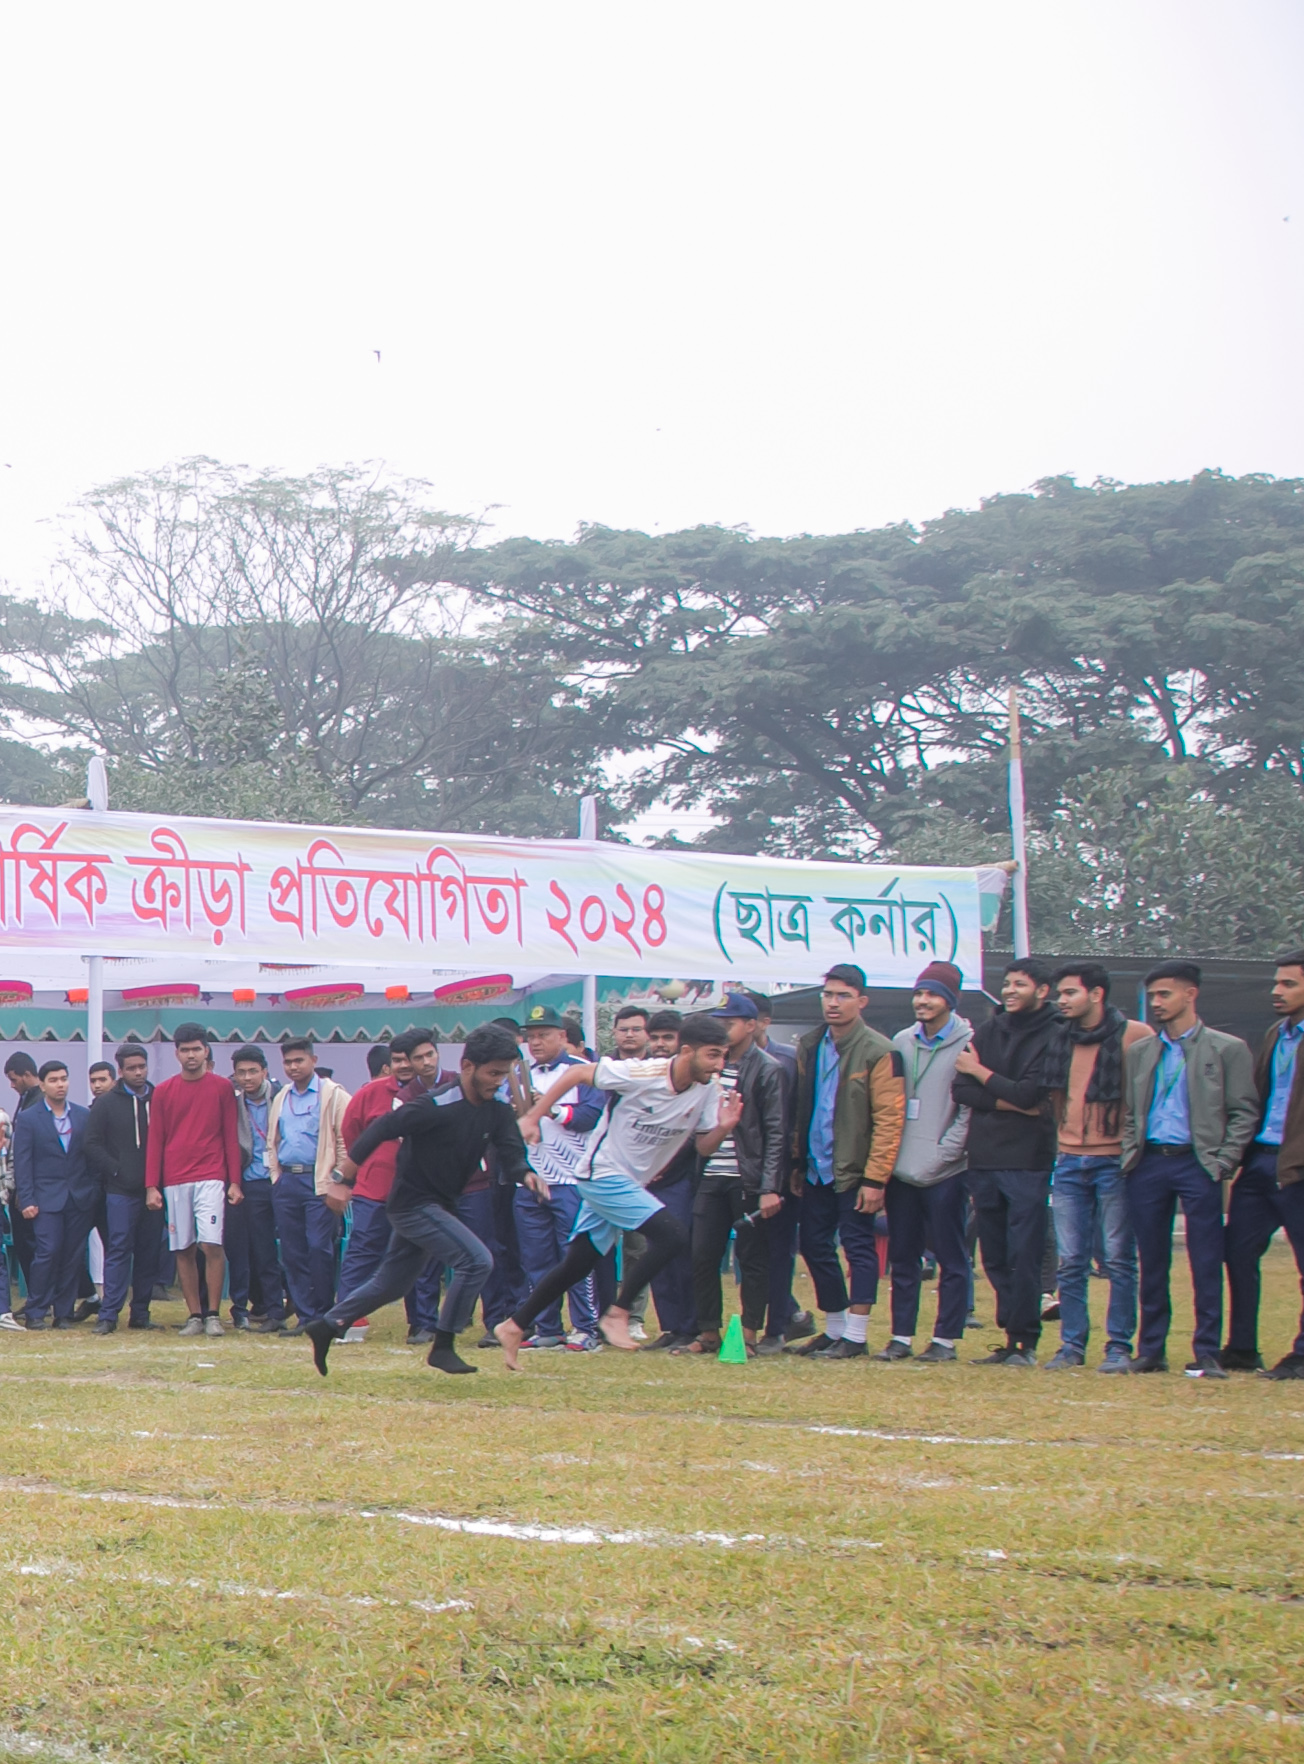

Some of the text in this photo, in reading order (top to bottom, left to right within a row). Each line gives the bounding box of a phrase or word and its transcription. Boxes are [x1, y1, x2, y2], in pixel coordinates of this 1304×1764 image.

[125, 828, 252, 946] ক্রীড়া
[268, 840, 526, 945] প্রতিযোগিতা
[547, 880, 667, 956] ২০২৪
[713, 876, 961, 970] (ছাত্র কর্নার)
[210, 1214, 217, 1225] 9
